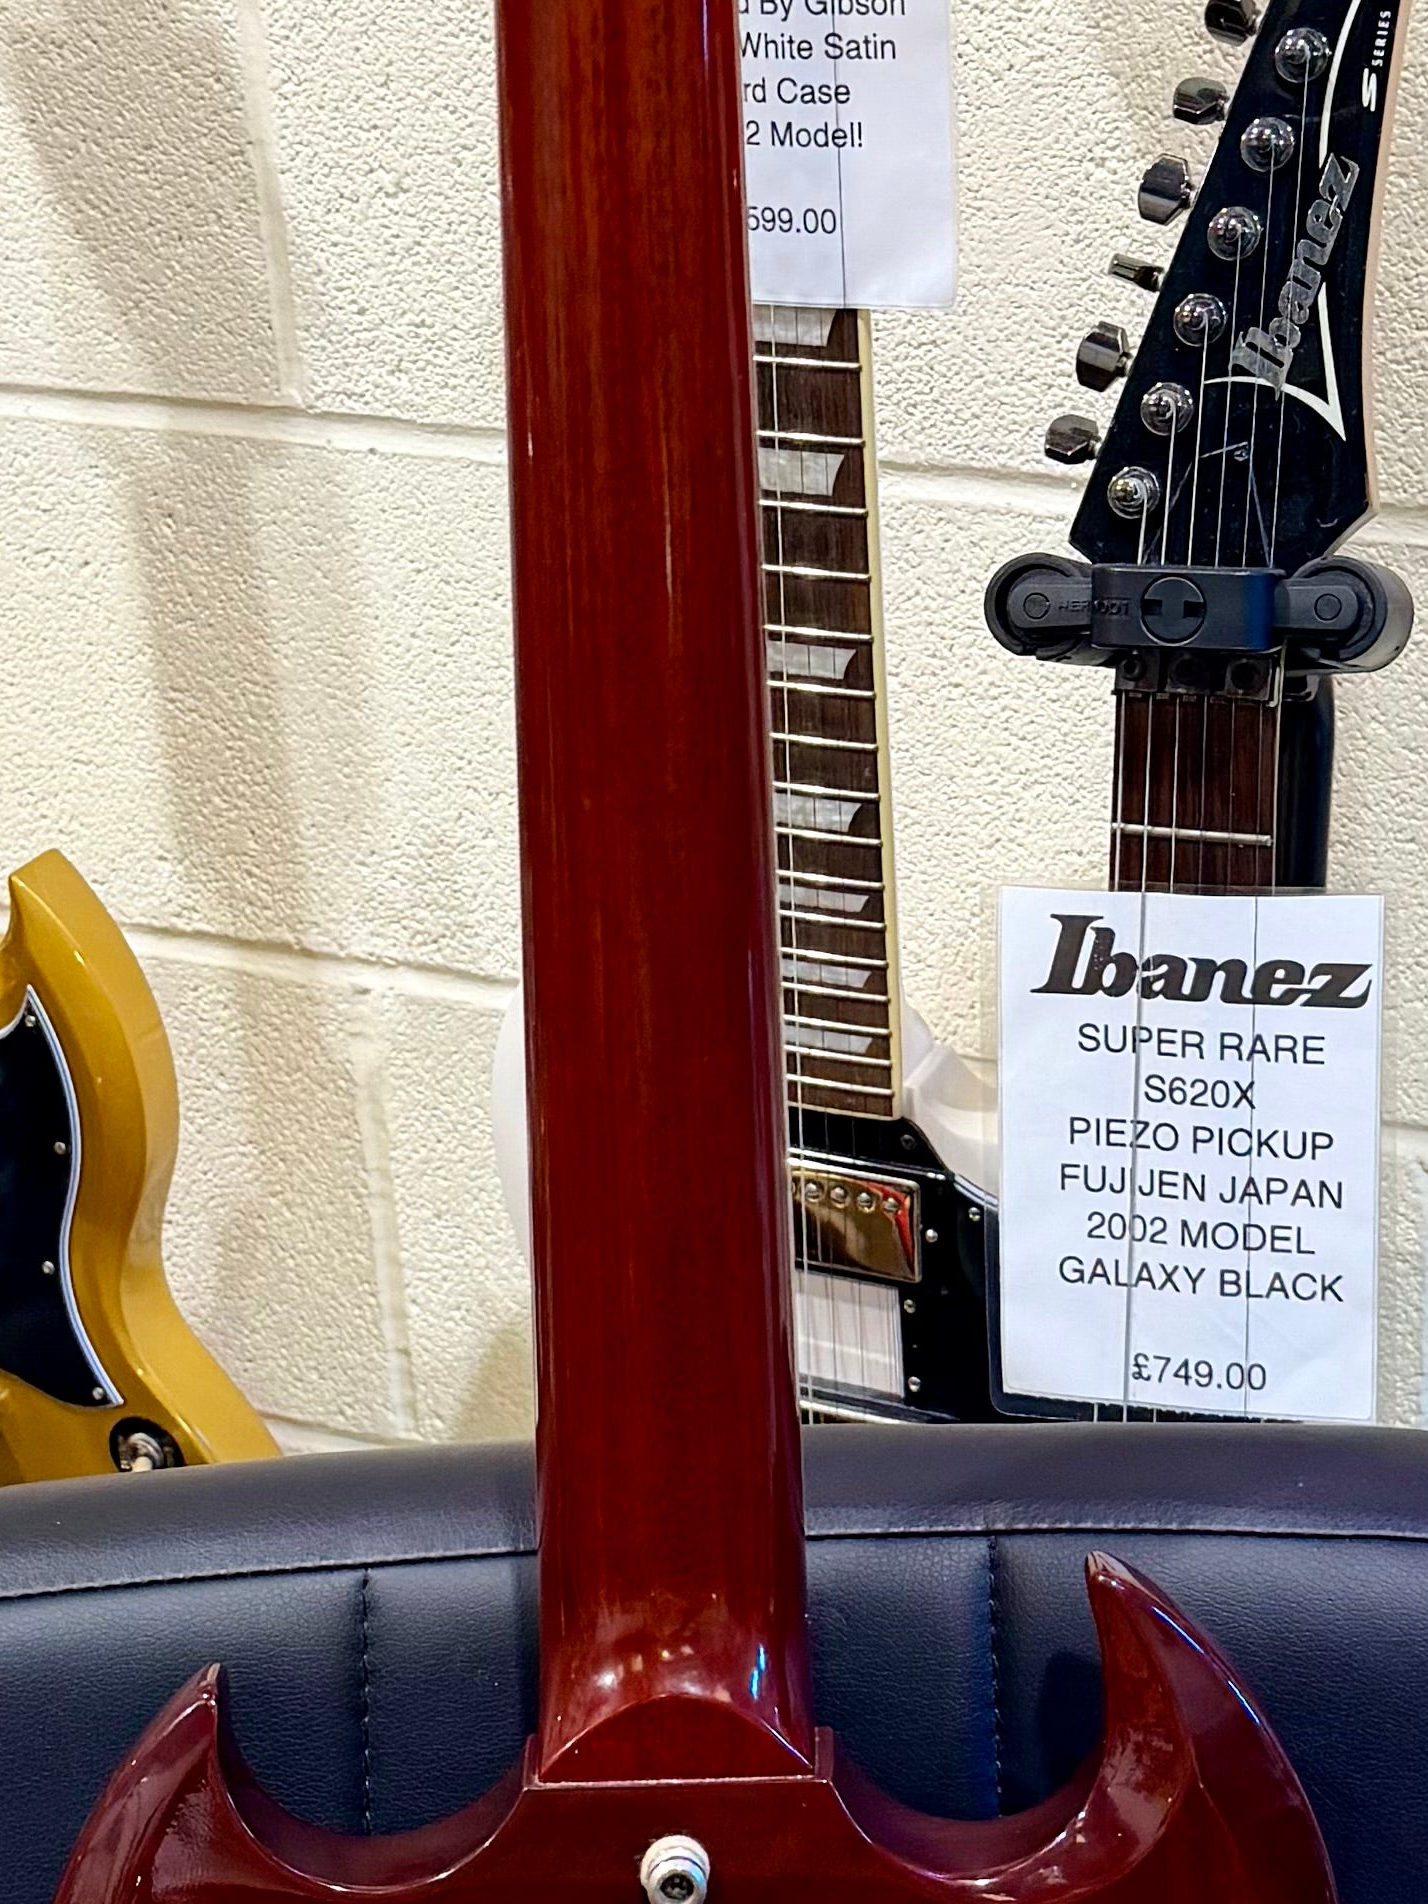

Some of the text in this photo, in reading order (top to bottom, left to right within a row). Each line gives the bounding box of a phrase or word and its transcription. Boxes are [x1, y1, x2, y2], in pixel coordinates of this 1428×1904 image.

[740, 32, 897, 60] White Satin
[1371, 10, 1392, 67] SERIES
[776, 78, 851, 105] Case
[770, 122, 864, 149] Model!
[747, 207, 837, 235] 599.00
[1229, 152, 1361, 401] Ibanez
[1029, 913, 1373, 1010] Ibanez
[1077, 1022, 1326, 1065] SUPER RARE
[1143, 1073, 1257, 1110] S620X
[1068, 1116, 1335, 1161] PIEZO PICKUP
[1219, 1175, 1344, 1209] JAPAN
[1086, 1212, 1316, 1255] 2002 MODEL
[1058, 1256, 1344, 1303] GALAXY BLACK
[1132, 1352, 1267, 1391] £749.00
